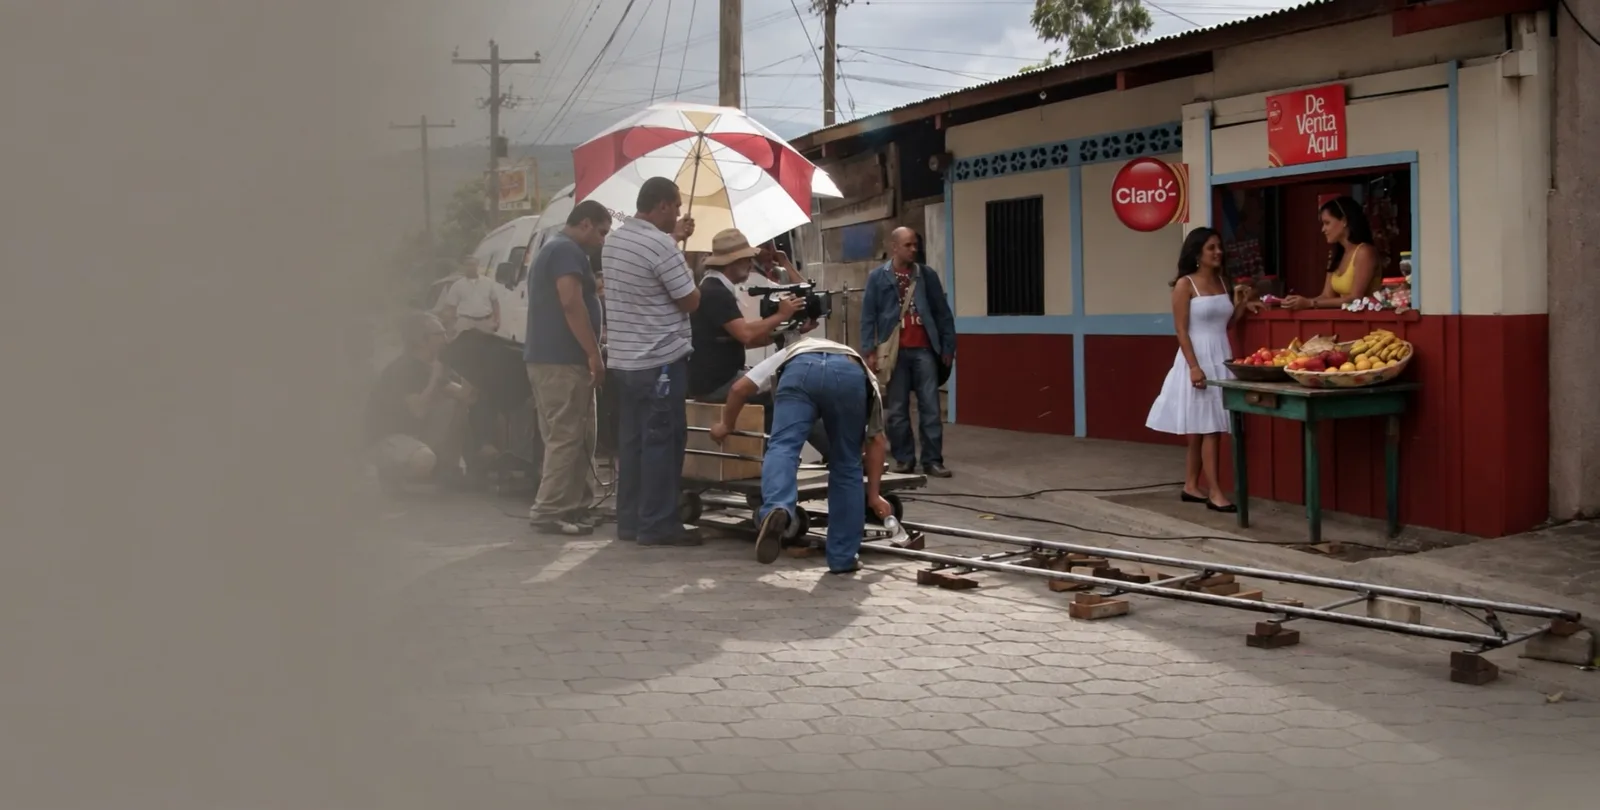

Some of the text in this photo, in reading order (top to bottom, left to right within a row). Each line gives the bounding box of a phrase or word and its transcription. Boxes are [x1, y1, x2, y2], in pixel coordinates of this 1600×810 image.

[1305, 94, 1325, 115] De
[1296, 112, 1337, 135] Venta
[1116, 184, 1169, 204] Claro
